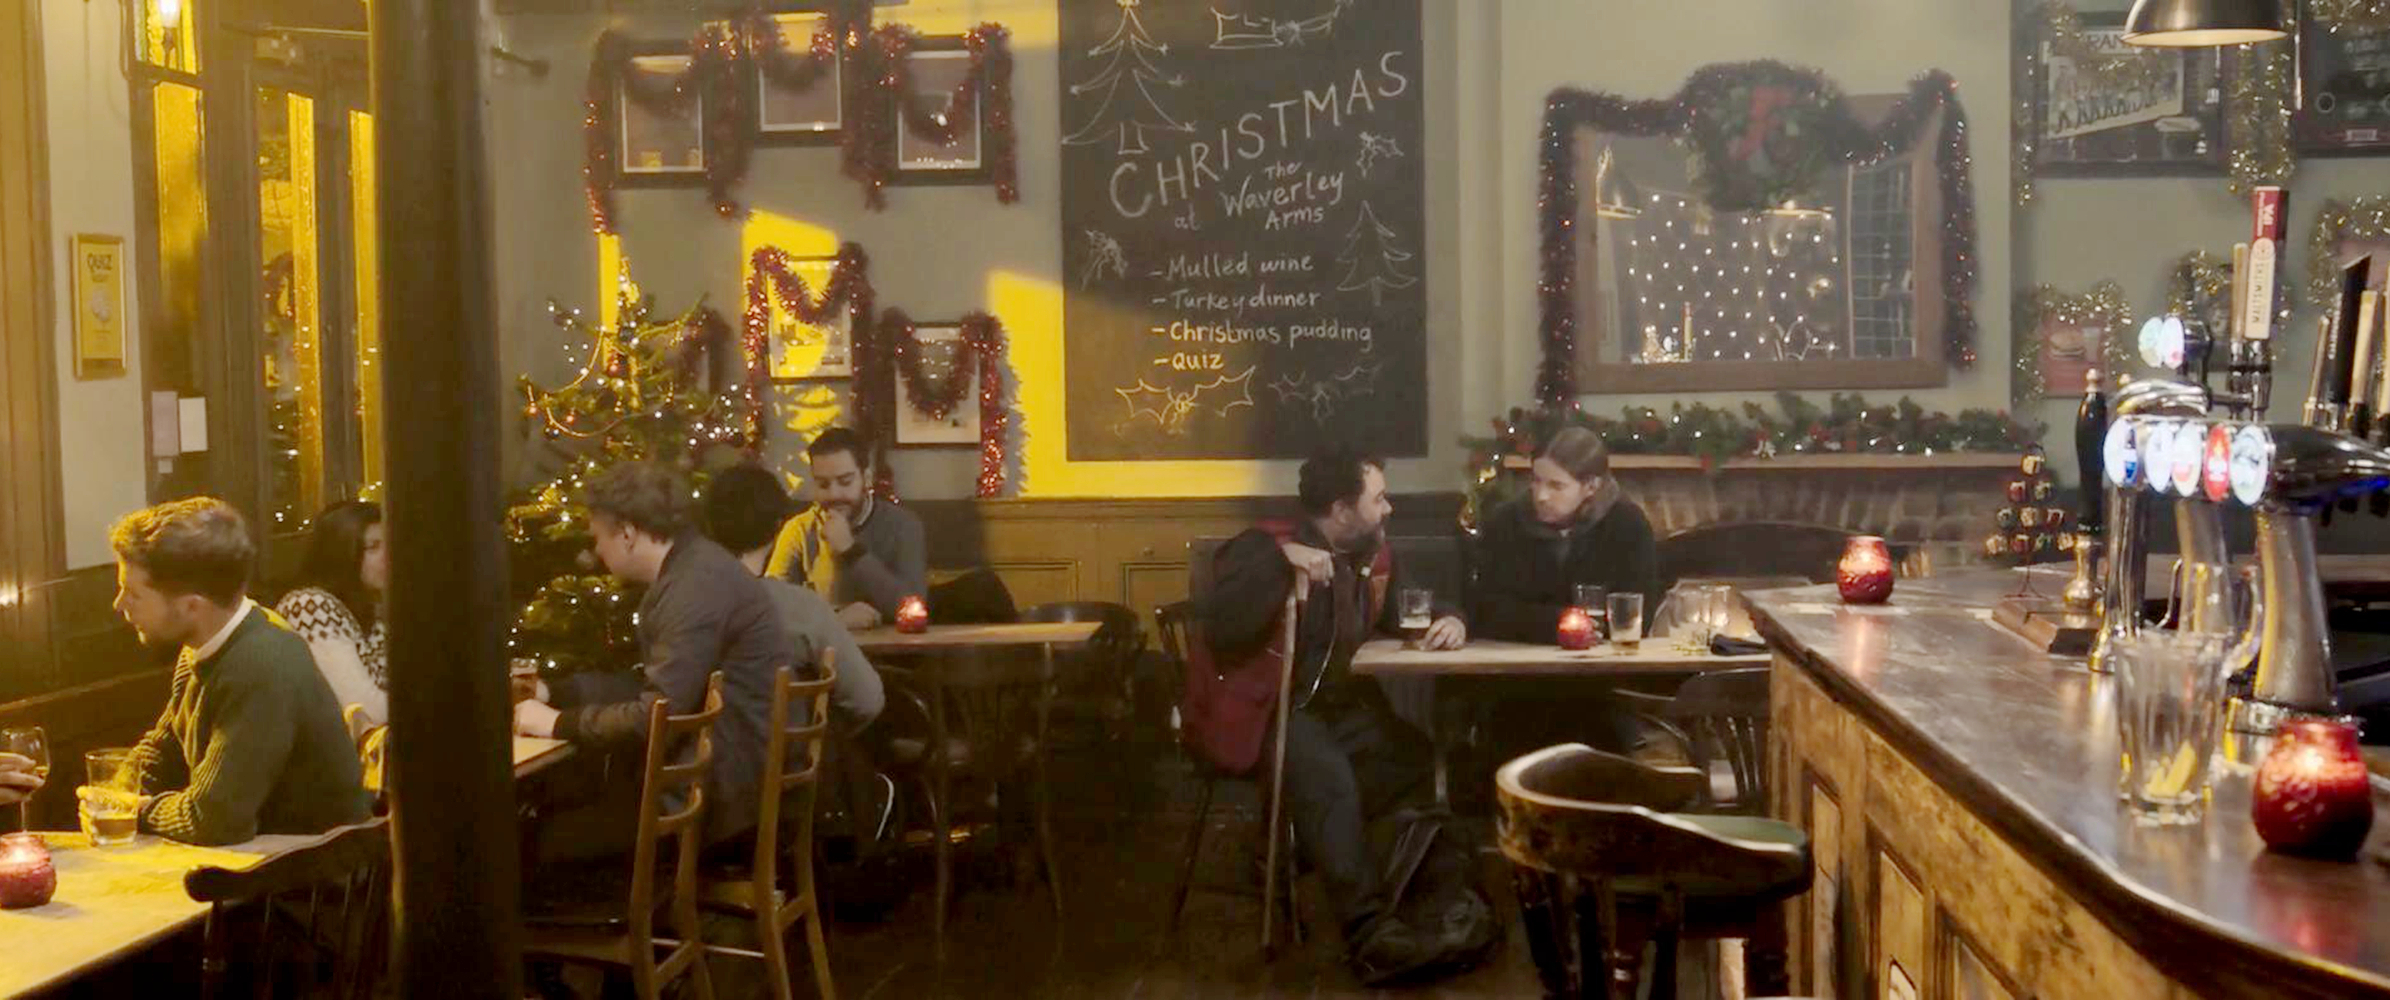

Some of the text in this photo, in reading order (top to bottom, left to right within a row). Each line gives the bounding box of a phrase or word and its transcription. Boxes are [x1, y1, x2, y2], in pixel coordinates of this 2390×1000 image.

[1109, 50, 1408, 218] CHRISTMAS
[1264, 161, 1301, 182] The
[1220, 171, 1344, 217] Waverley
[1174, 205, 1199, 231] at
[1265, 207, 1325, 231] Arms
[1260, 252, 1315, 273] wine
[1249, 284, 1321, 308] dinner
[1289, 321, 1373, 353] pudding
